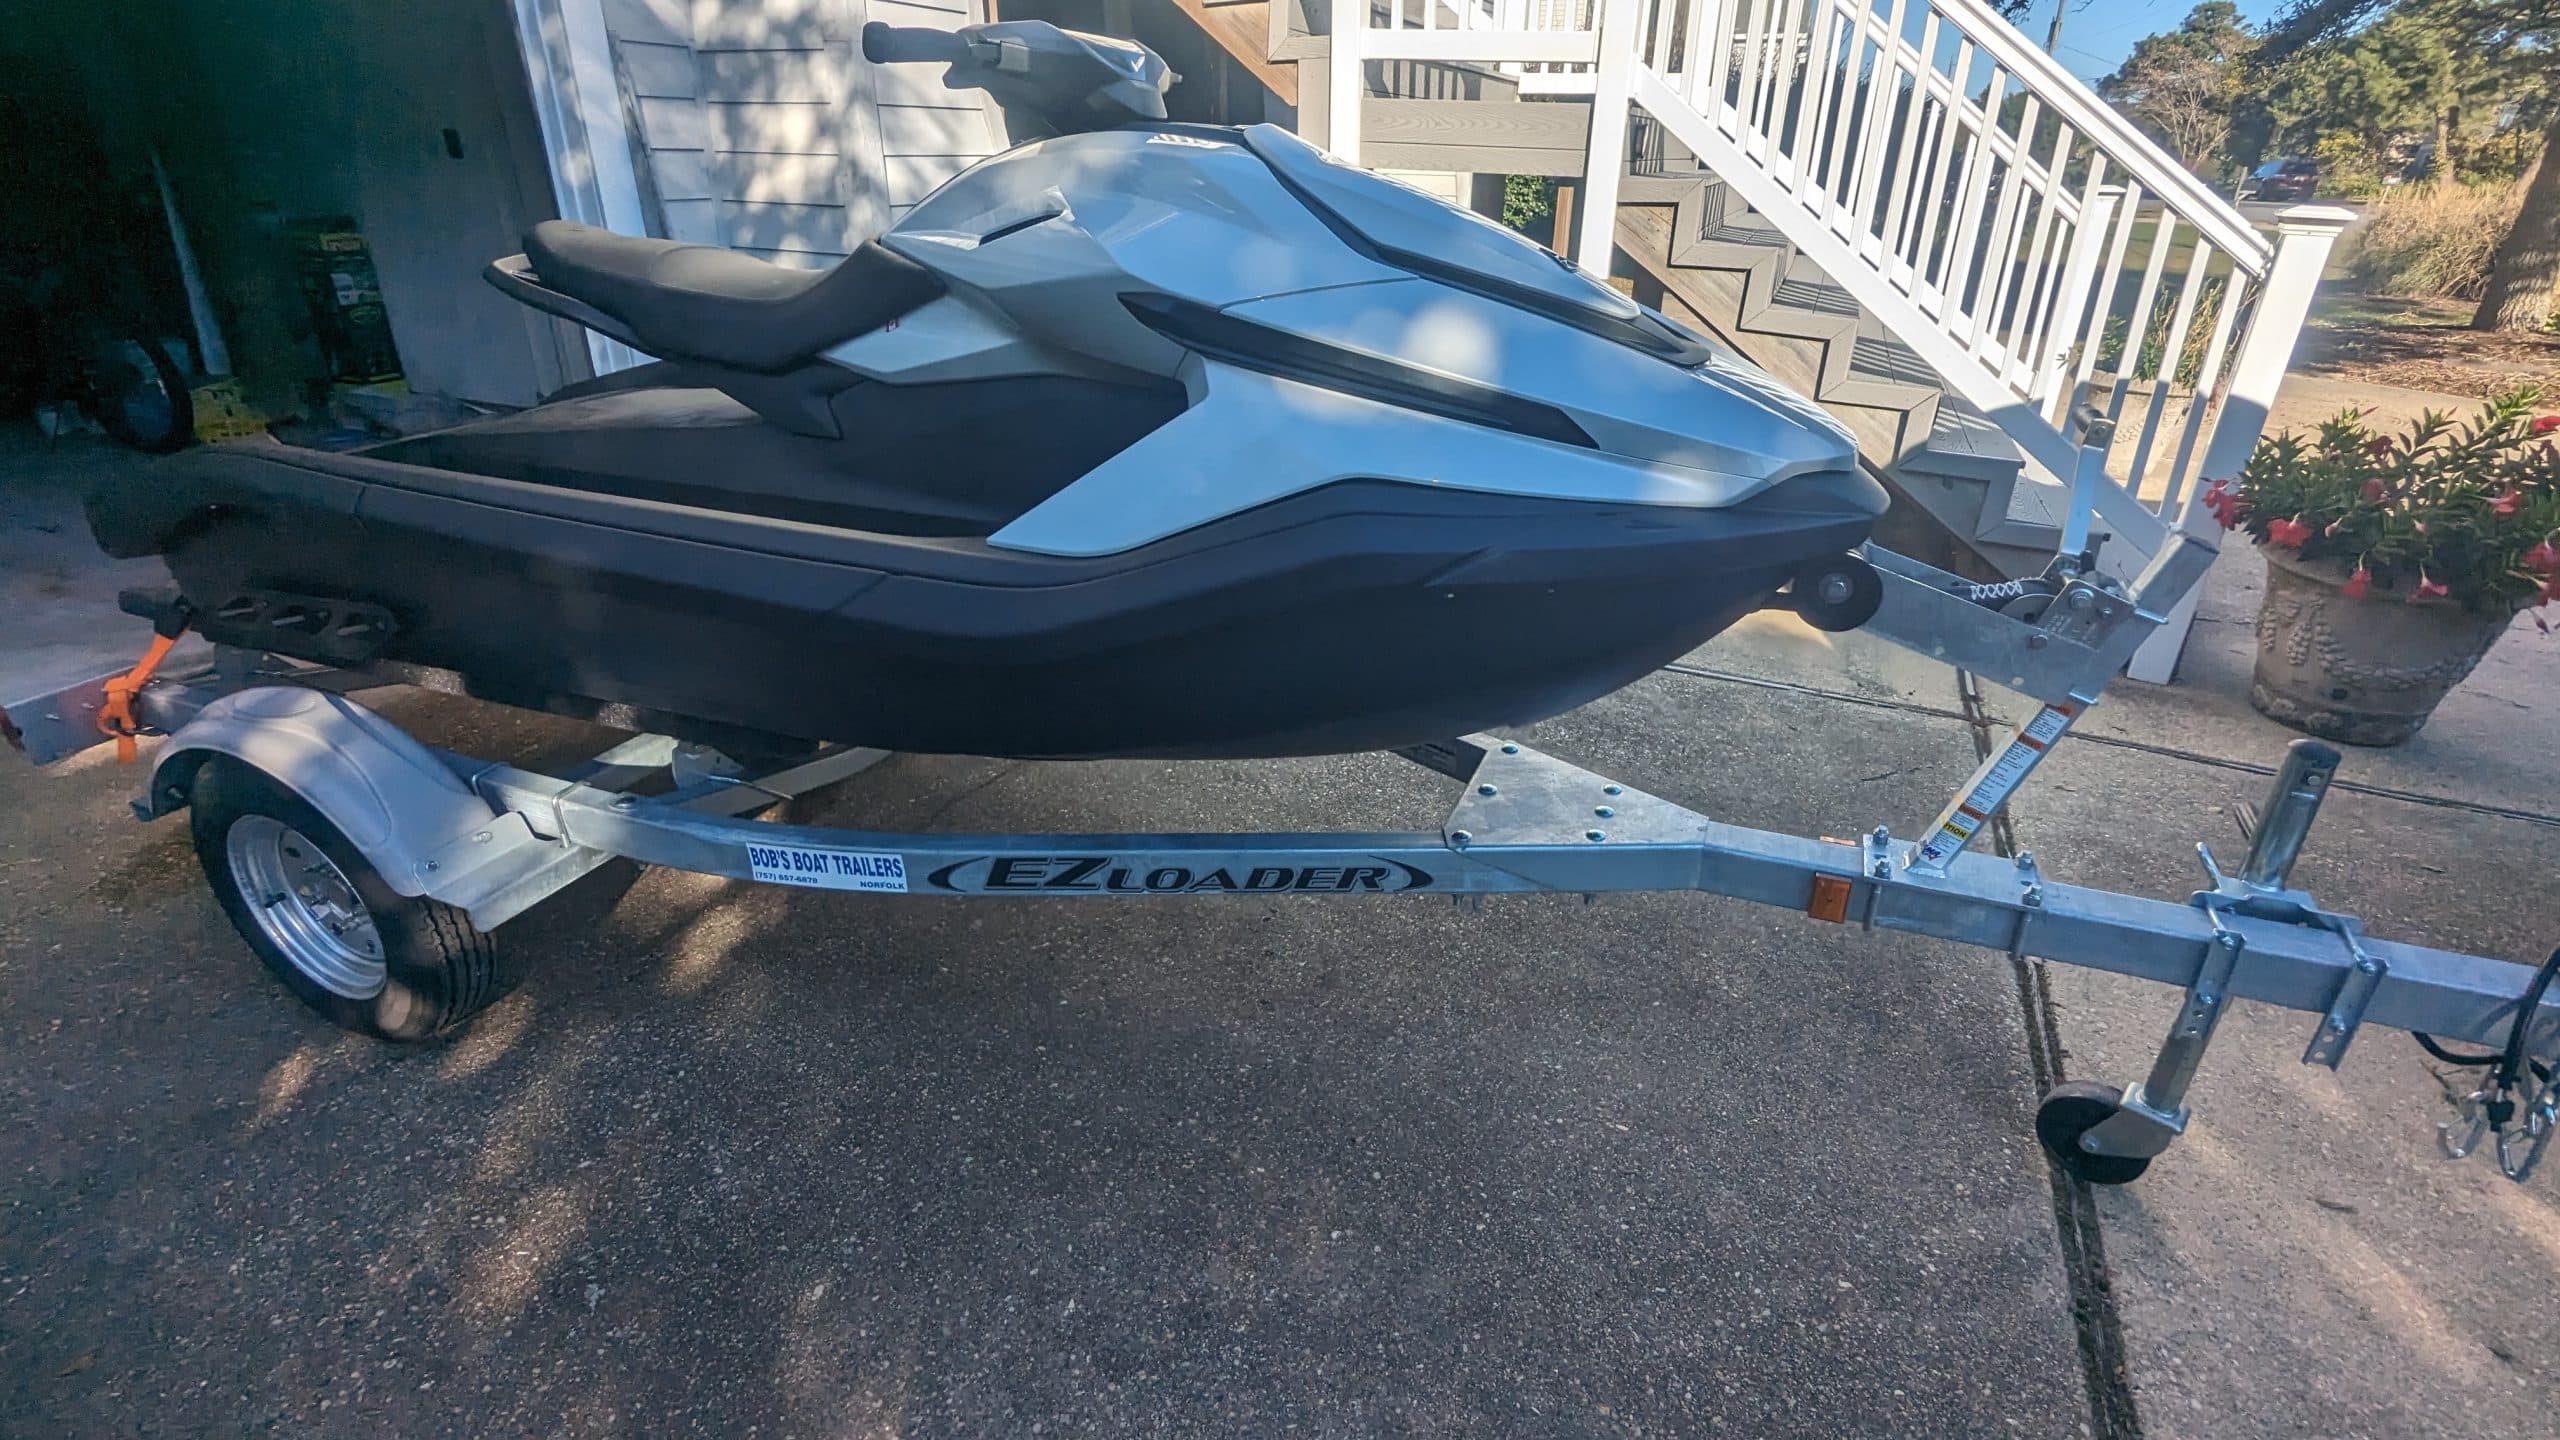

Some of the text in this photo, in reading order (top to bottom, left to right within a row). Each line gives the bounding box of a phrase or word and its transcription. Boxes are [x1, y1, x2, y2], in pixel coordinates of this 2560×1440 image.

[749, 847, 903, 878] BOB'S BOAT TRAILERS
[859, 881, 905, 889] NORFOLK
